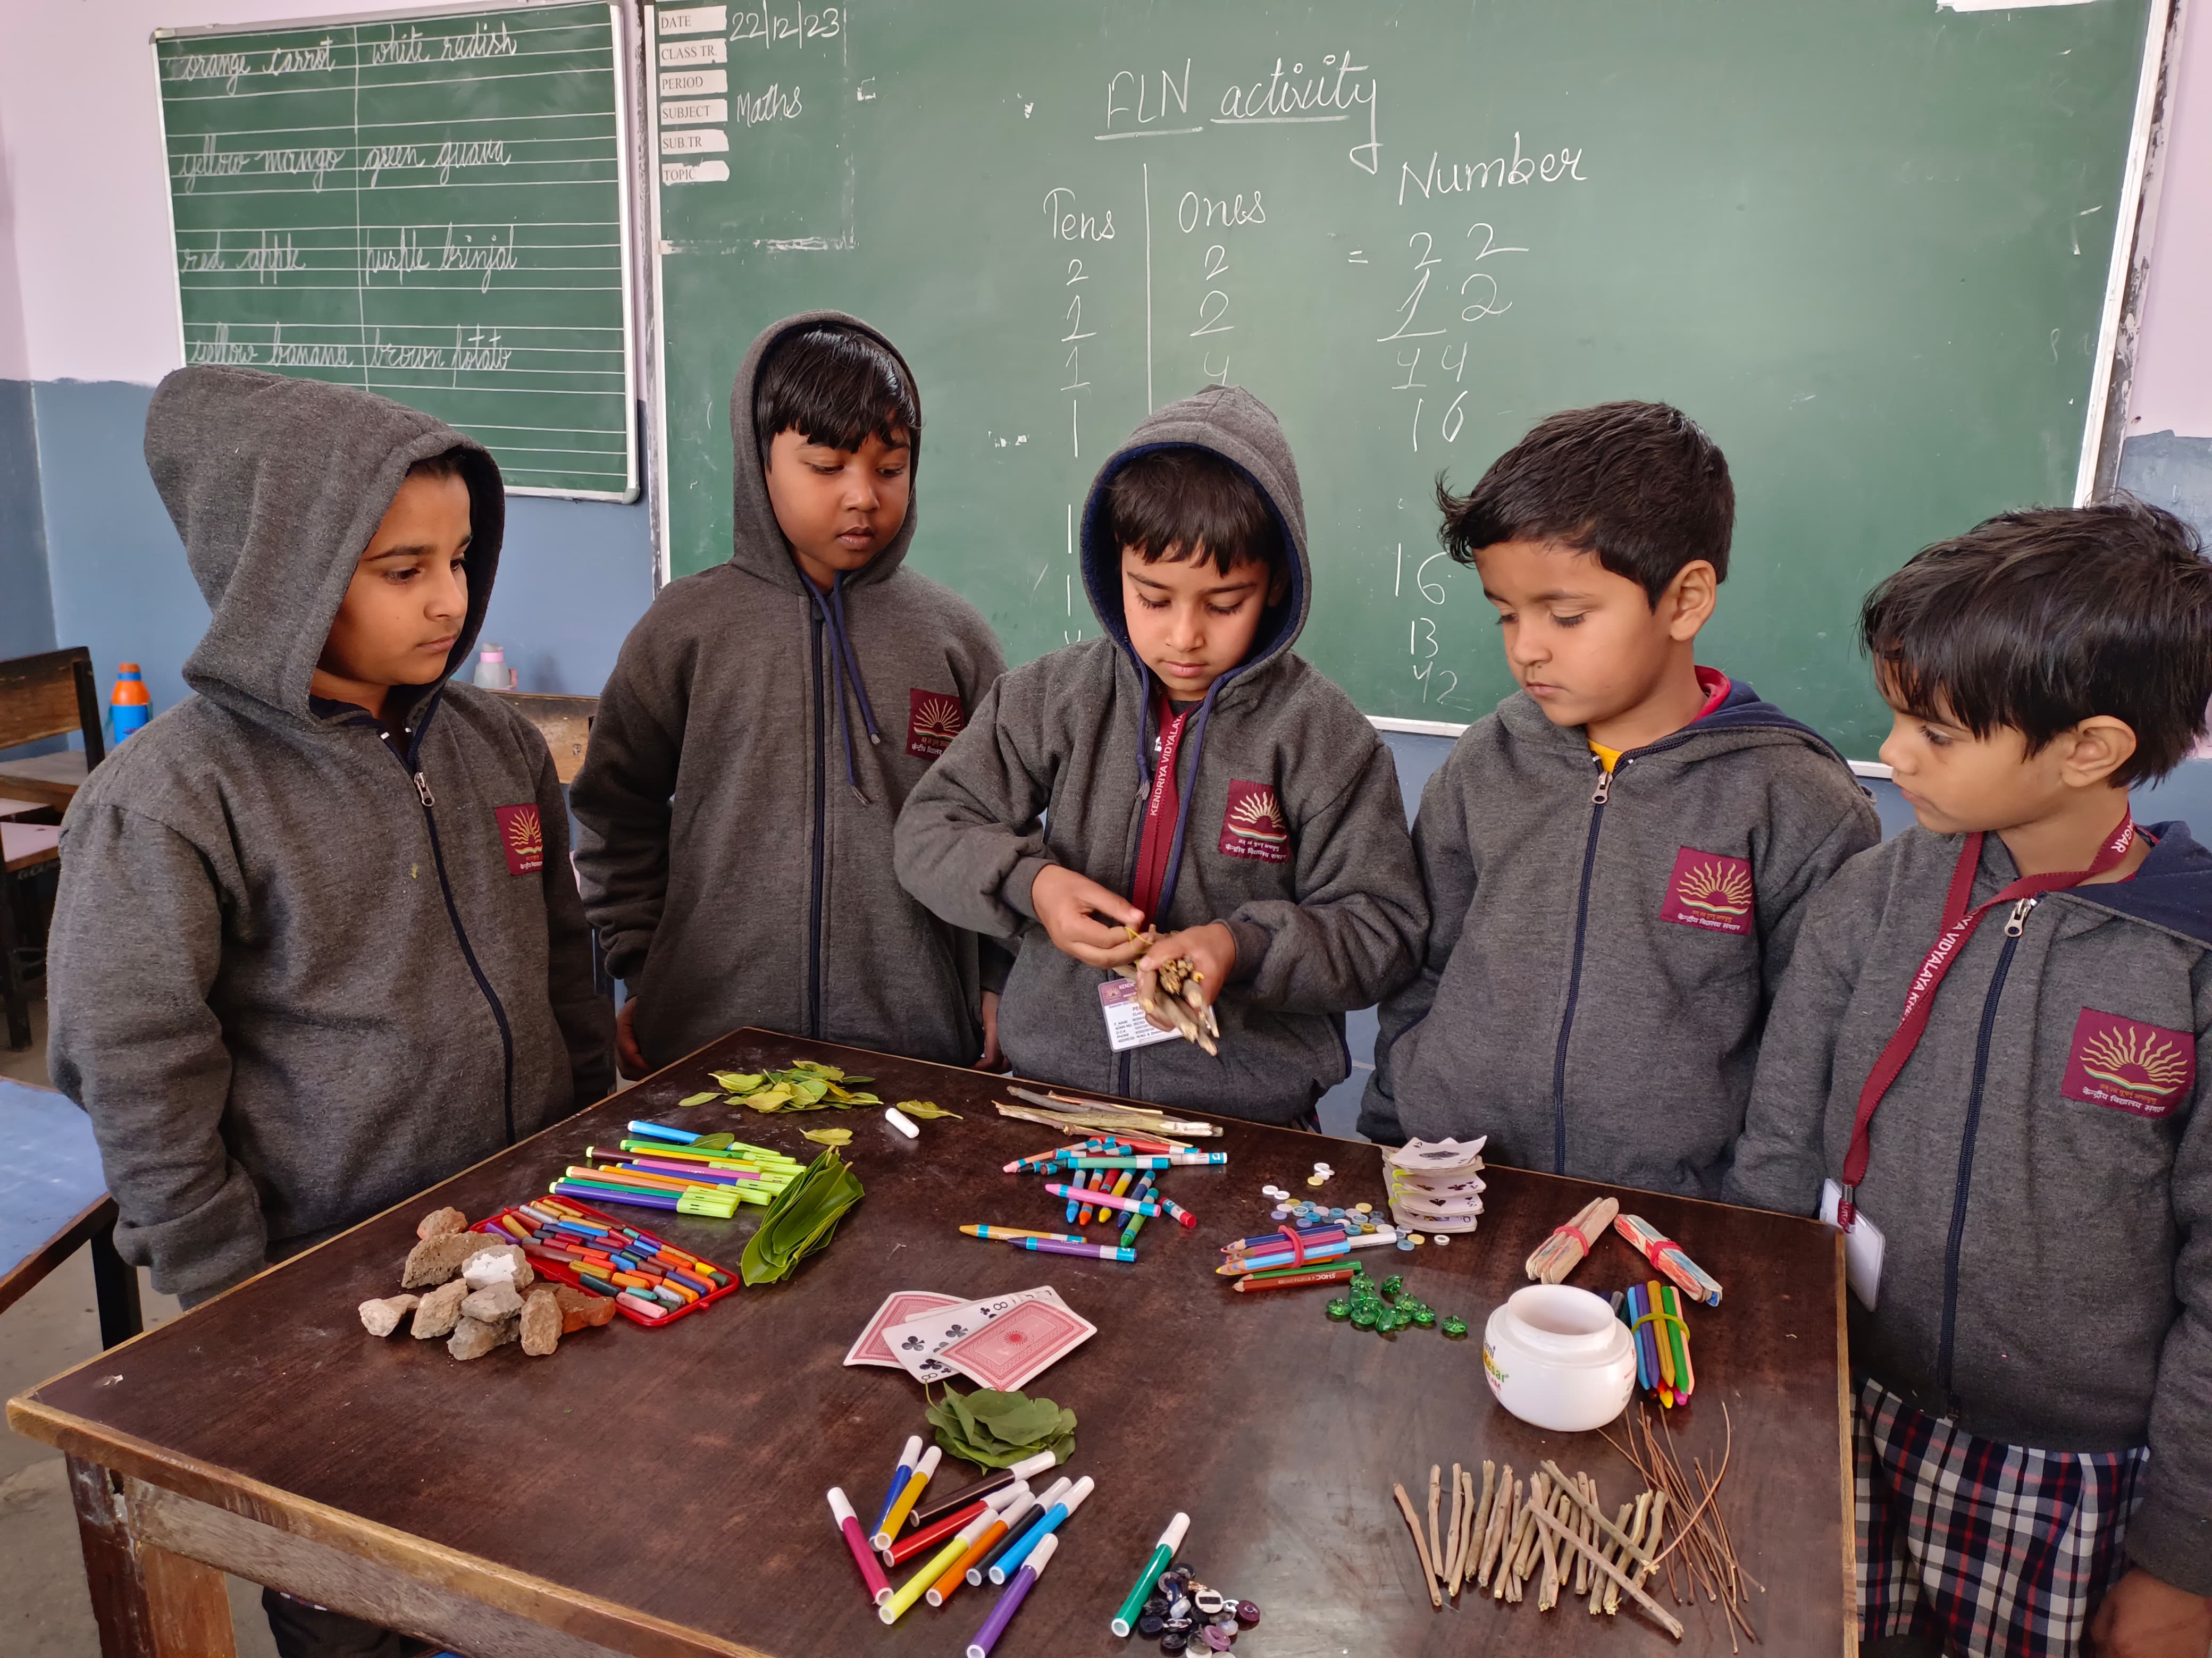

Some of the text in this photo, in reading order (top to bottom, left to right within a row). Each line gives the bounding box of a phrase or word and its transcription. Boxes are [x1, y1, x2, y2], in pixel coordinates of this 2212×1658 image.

[372, 23, 430, 64] white
[661, 15, 691, 30] DATE
[729, 0, 840, 49] 22/12/23
[182, 35, 336, 96] orange carrot
[661, 46, 697, 61] CLASS
[662, 75, 703, 90] PERIOD
[736, 83, 802, 128] Maths
[663, 105, 711, 120] SUBJECT
[1107, 50, 1384, 174] FLN activity
[179, 134, 346, 194] yellow mango
[362, 139, 512, 188] green guava
[663, 168, 696, 181] TOPIC
[1398, 131, 1588, 206] Number
[1043, 187, 1116, 241] Tens
[1178, 191, 1267, 234] Ones
[180, 229, 306, 284] red apple
[366, 221, 517, 293] purple brinjal
[1066, 258, 1089, 286] 2
[1204, 245, 1229, 281] 2
[1190, 290, 1235, 337] 2
[266, 321, 354, 367] banana
[370, 323, 512, 388] brown potato
[1150, 712, 1186, 817] KENDRIYA VIDYALAYA
[1913, 932, 1960, 991] VIDYALAYA
